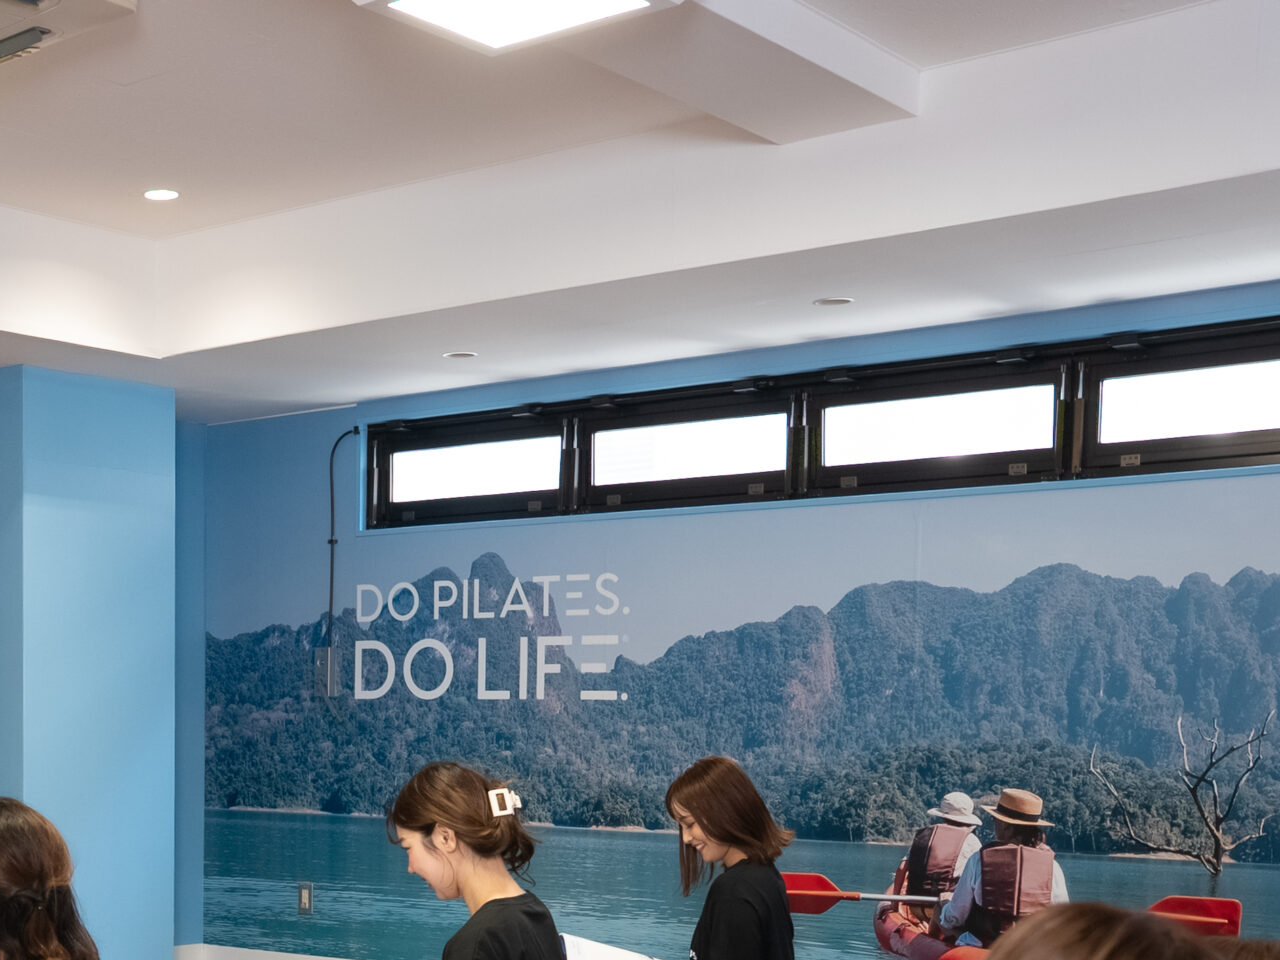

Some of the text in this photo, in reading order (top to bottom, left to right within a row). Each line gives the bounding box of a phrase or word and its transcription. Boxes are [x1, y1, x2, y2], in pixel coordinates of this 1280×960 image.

[356, 572, 631, 623] DO PILATES.
[354, 635, 629, 701] DO LIFE.
